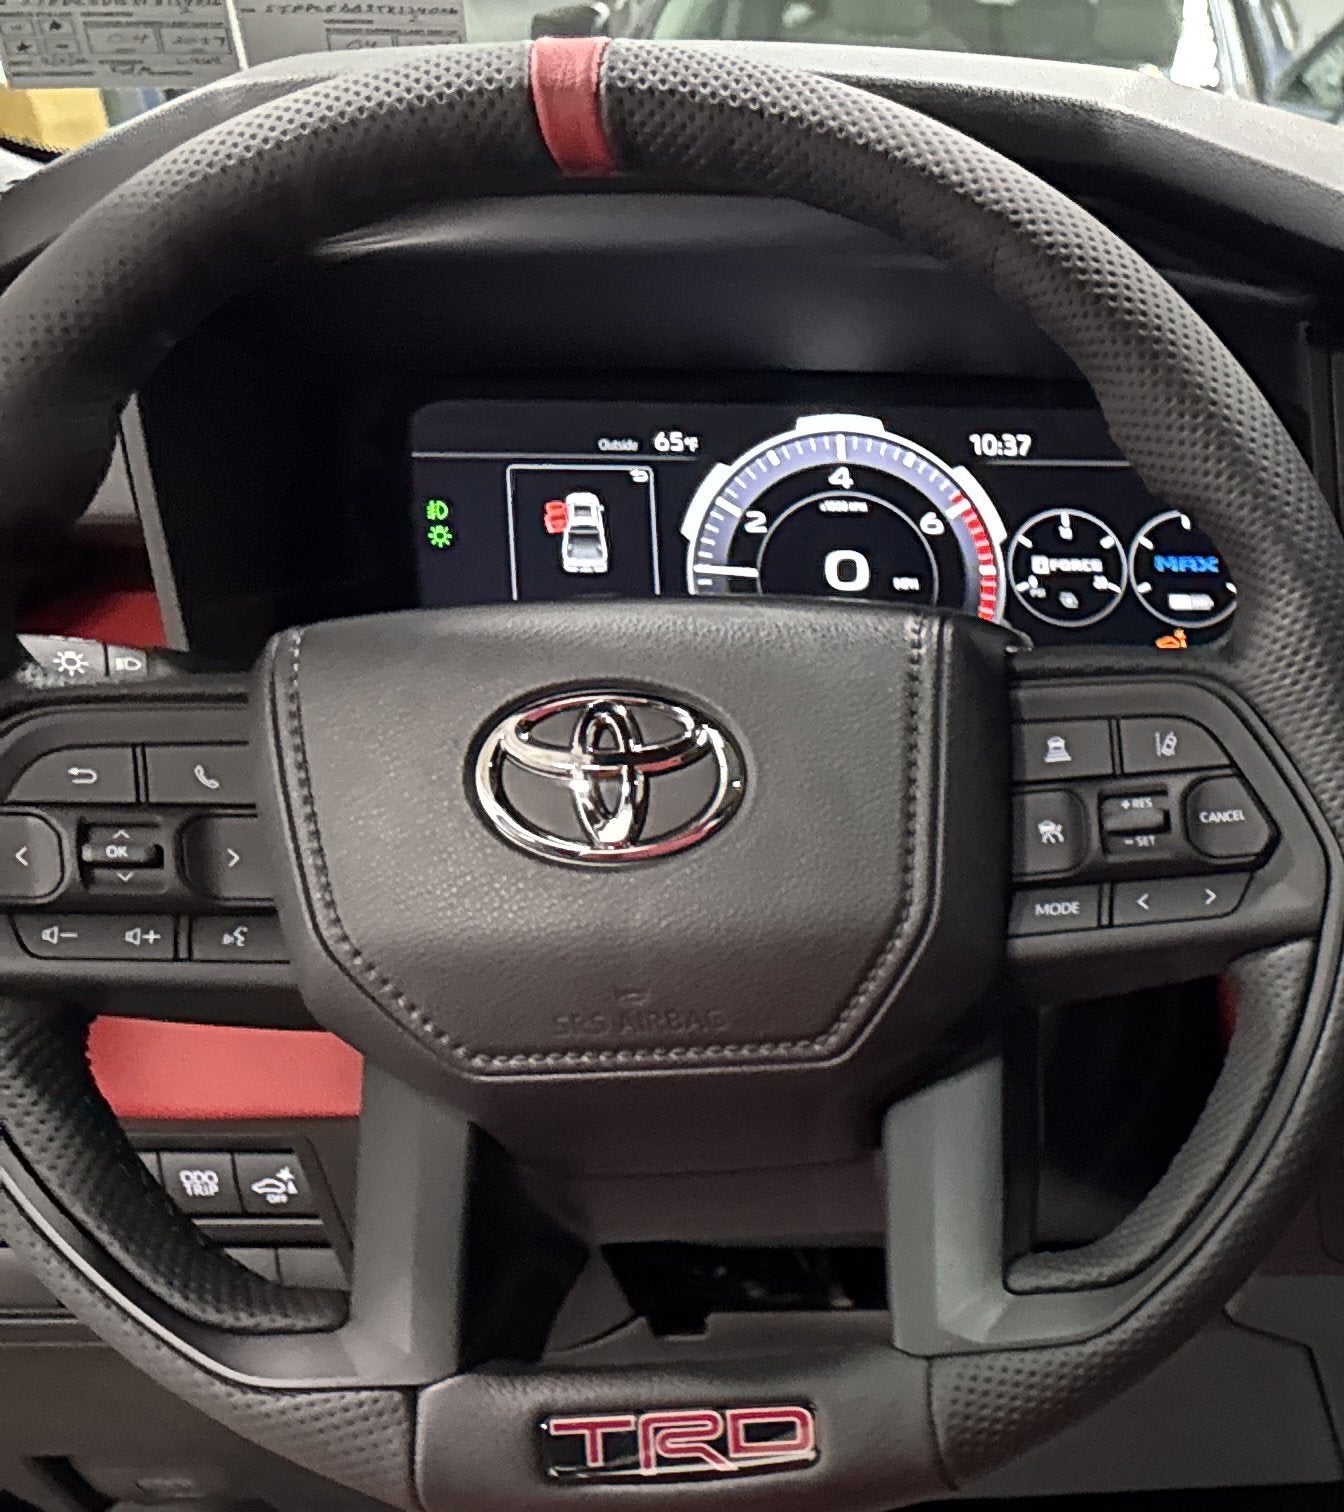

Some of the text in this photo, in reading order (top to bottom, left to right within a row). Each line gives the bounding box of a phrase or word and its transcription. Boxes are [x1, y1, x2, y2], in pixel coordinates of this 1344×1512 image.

[968, 432, 1032, 457] 10:37
[828, 467, 855, 489] 4
[744, 511, 768, 534] 2
[919, 511, 945, 535] 6
[824, 549, 870, 592] 0
[1153, 555, 1219, 573] MAX
[1199, 809, 1245, 823] CANCEL
[105, 845, 128, 858] OK
[1035, 900, 1080, 916] MODE
[549, 1406, 816, 1476] TRD
